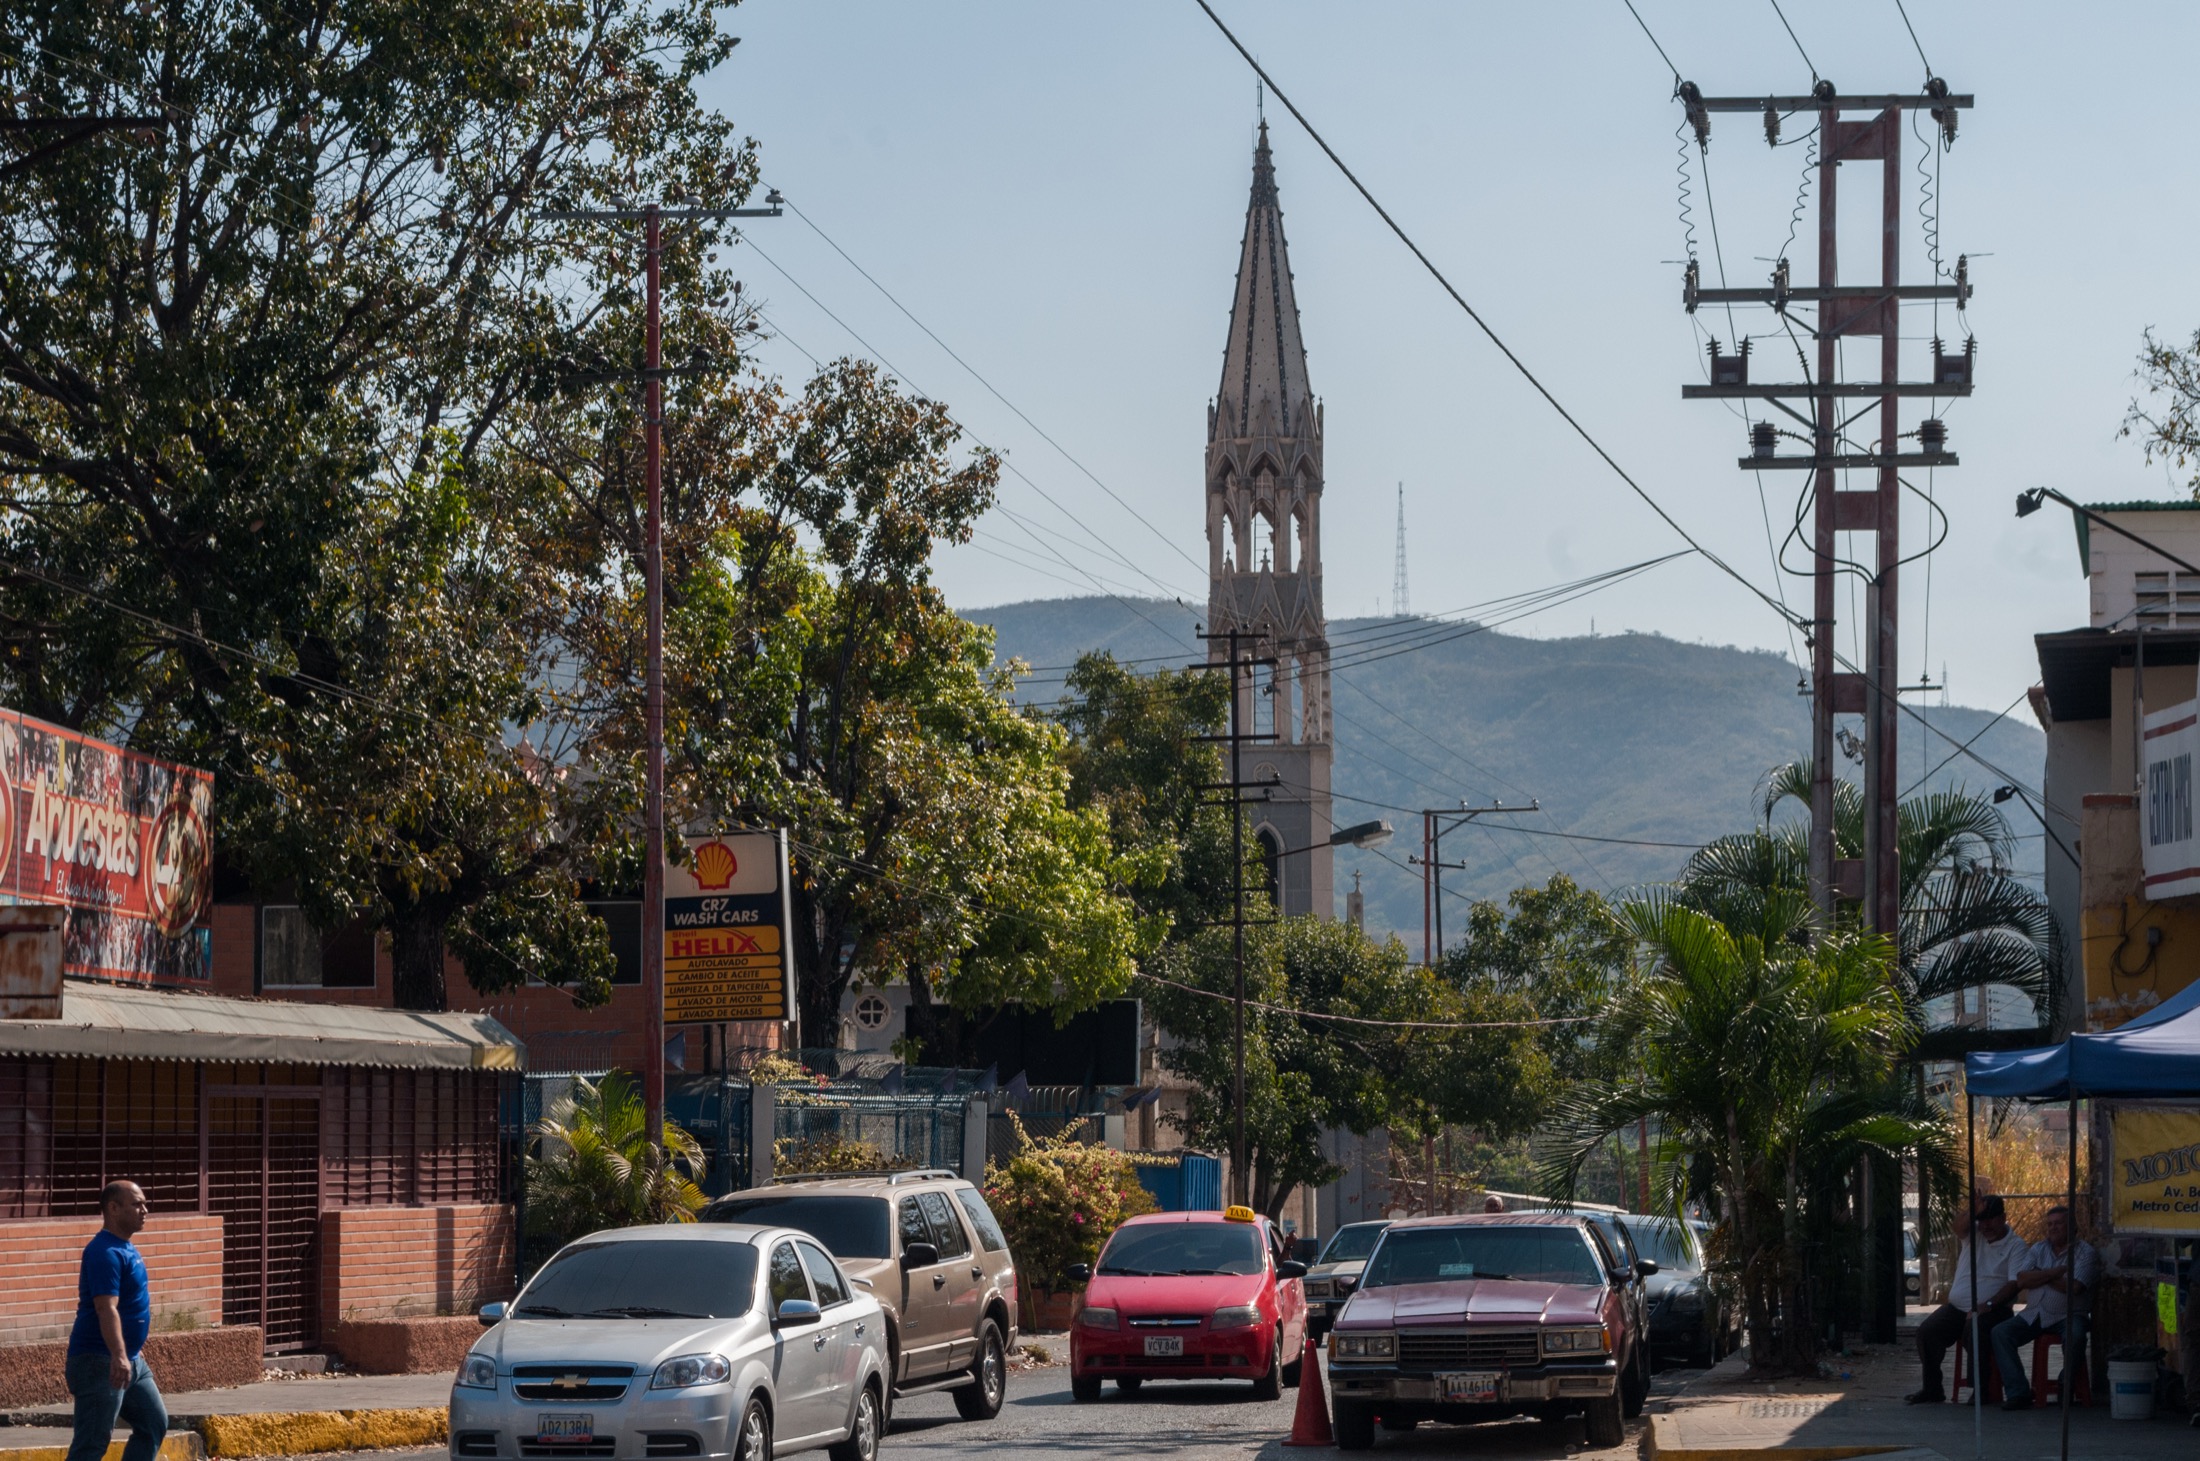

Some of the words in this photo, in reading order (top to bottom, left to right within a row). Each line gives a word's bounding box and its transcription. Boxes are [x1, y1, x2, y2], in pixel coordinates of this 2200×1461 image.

[25, 768, 140, 881] Apuestas
[56, 869, 65, 894] El
[701, 898, 729, 911] CR7
[674, 912, 717, 926] WASH
[722, 910, 759, 923] CARS
[672, 930, 696, 938] Shell
[672, 935, 759, 956] HELIX
[688, 958, 748, 968] AUTOLAVADO
[678, 972, 714, 981] CAMBIO
[717, 971, 728, 979] DE
[731, 970, 760, 978] ACEITE
[669, 985, 709, 995] LIMPIEZA
[712, 984, 723, 992] DE
[726, 981, 770, 991] TAPICERÍA
[677, 997, 713, 1006] LAVADO
[716, 996, 727, 1005] DE
[729, 995, 763, 1004] MOTOR
[678, 1009, 714, 1019] LAVADO
[717, 1009, 728, 1017] DE
[730, 1007, 763, 1016] CHASIS
[2164, 1186, 2184, 1197] Av.
[2132, 1201, 2170, 1212] Metro
[1229, 1208, 1249, 1218] TAXI
[1165, 1340, 1180, 1351] 84K
[541, 1420, 588, 1436] AD213BA
